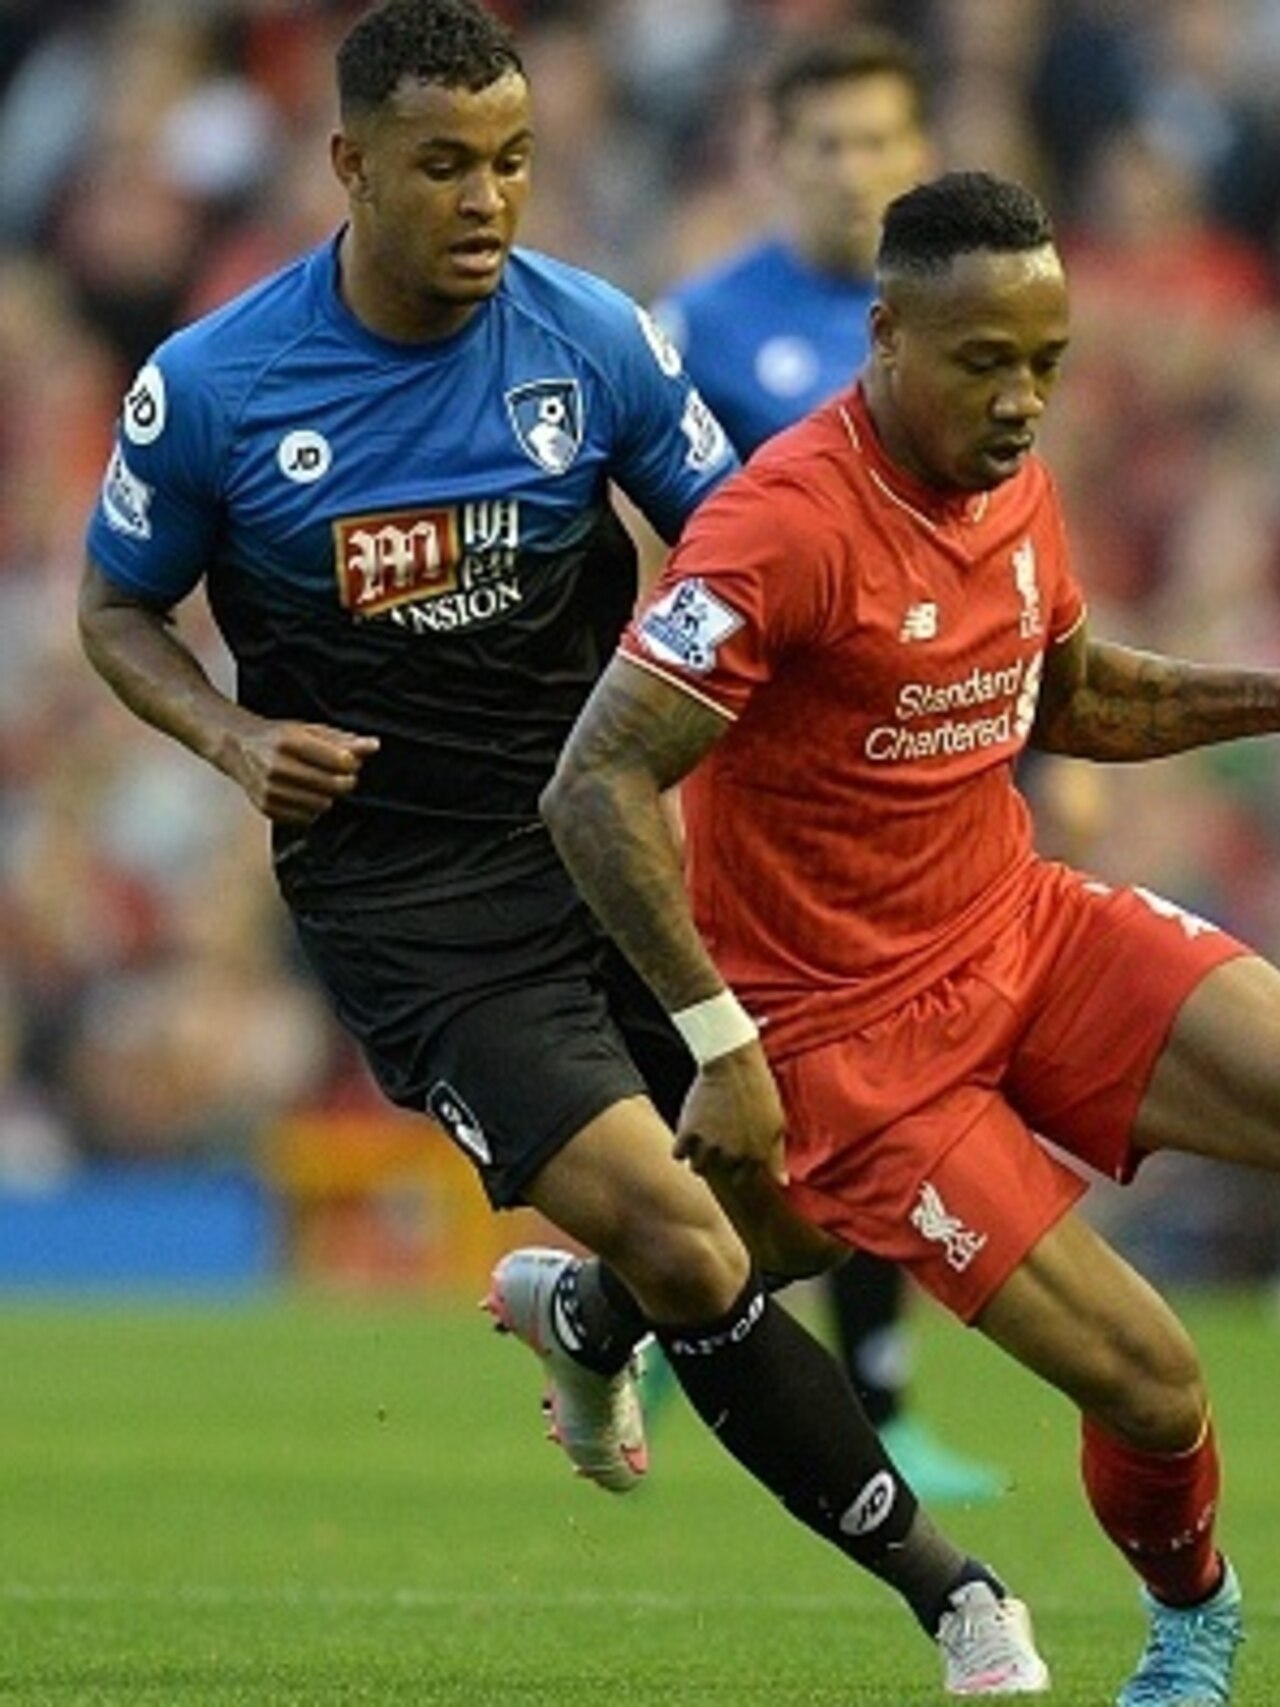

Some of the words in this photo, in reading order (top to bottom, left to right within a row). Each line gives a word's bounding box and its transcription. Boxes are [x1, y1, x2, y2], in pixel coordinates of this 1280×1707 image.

[288, 447, 321, 471] JD
[896, 657, 1023, 721] Standard
[865, 704, 1016, 760] Chartered
